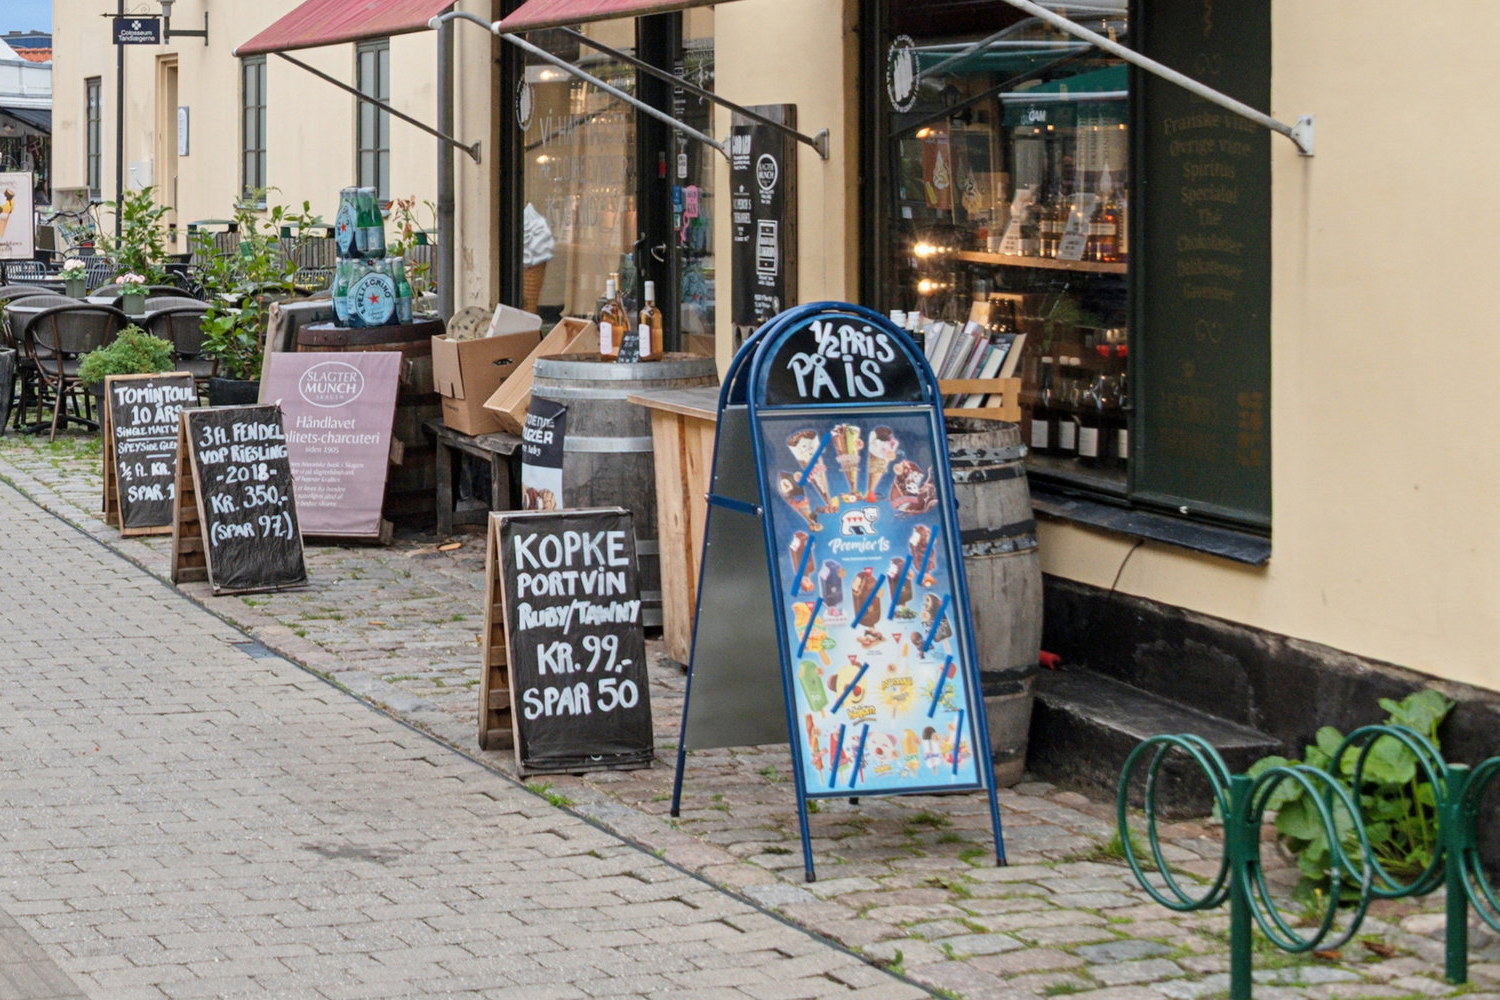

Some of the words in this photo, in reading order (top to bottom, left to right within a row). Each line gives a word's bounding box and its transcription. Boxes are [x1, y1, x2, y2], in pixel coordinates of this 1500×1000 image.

[118, 34, 156, 43] Tandlægerne
[307, 371, 357, 383] SLAGTER
[786, 352, 840, 398] PÅ
[304, 382, 356, 394] MUNCH
[131, 405, 152, 425] 10
[296, 415, 356, 429] Håndlavet
[232, 421, 285, 441] FENDEL
[211, 492, 240, 514] KR.
[514, 530, 629, 570] KOPKE
[828, 536, 878, 555] Premier
[537, 641, 581, 675] KR.
[523, 685, 591, 720] SPAR
[597, 678, 639, 711] 50
